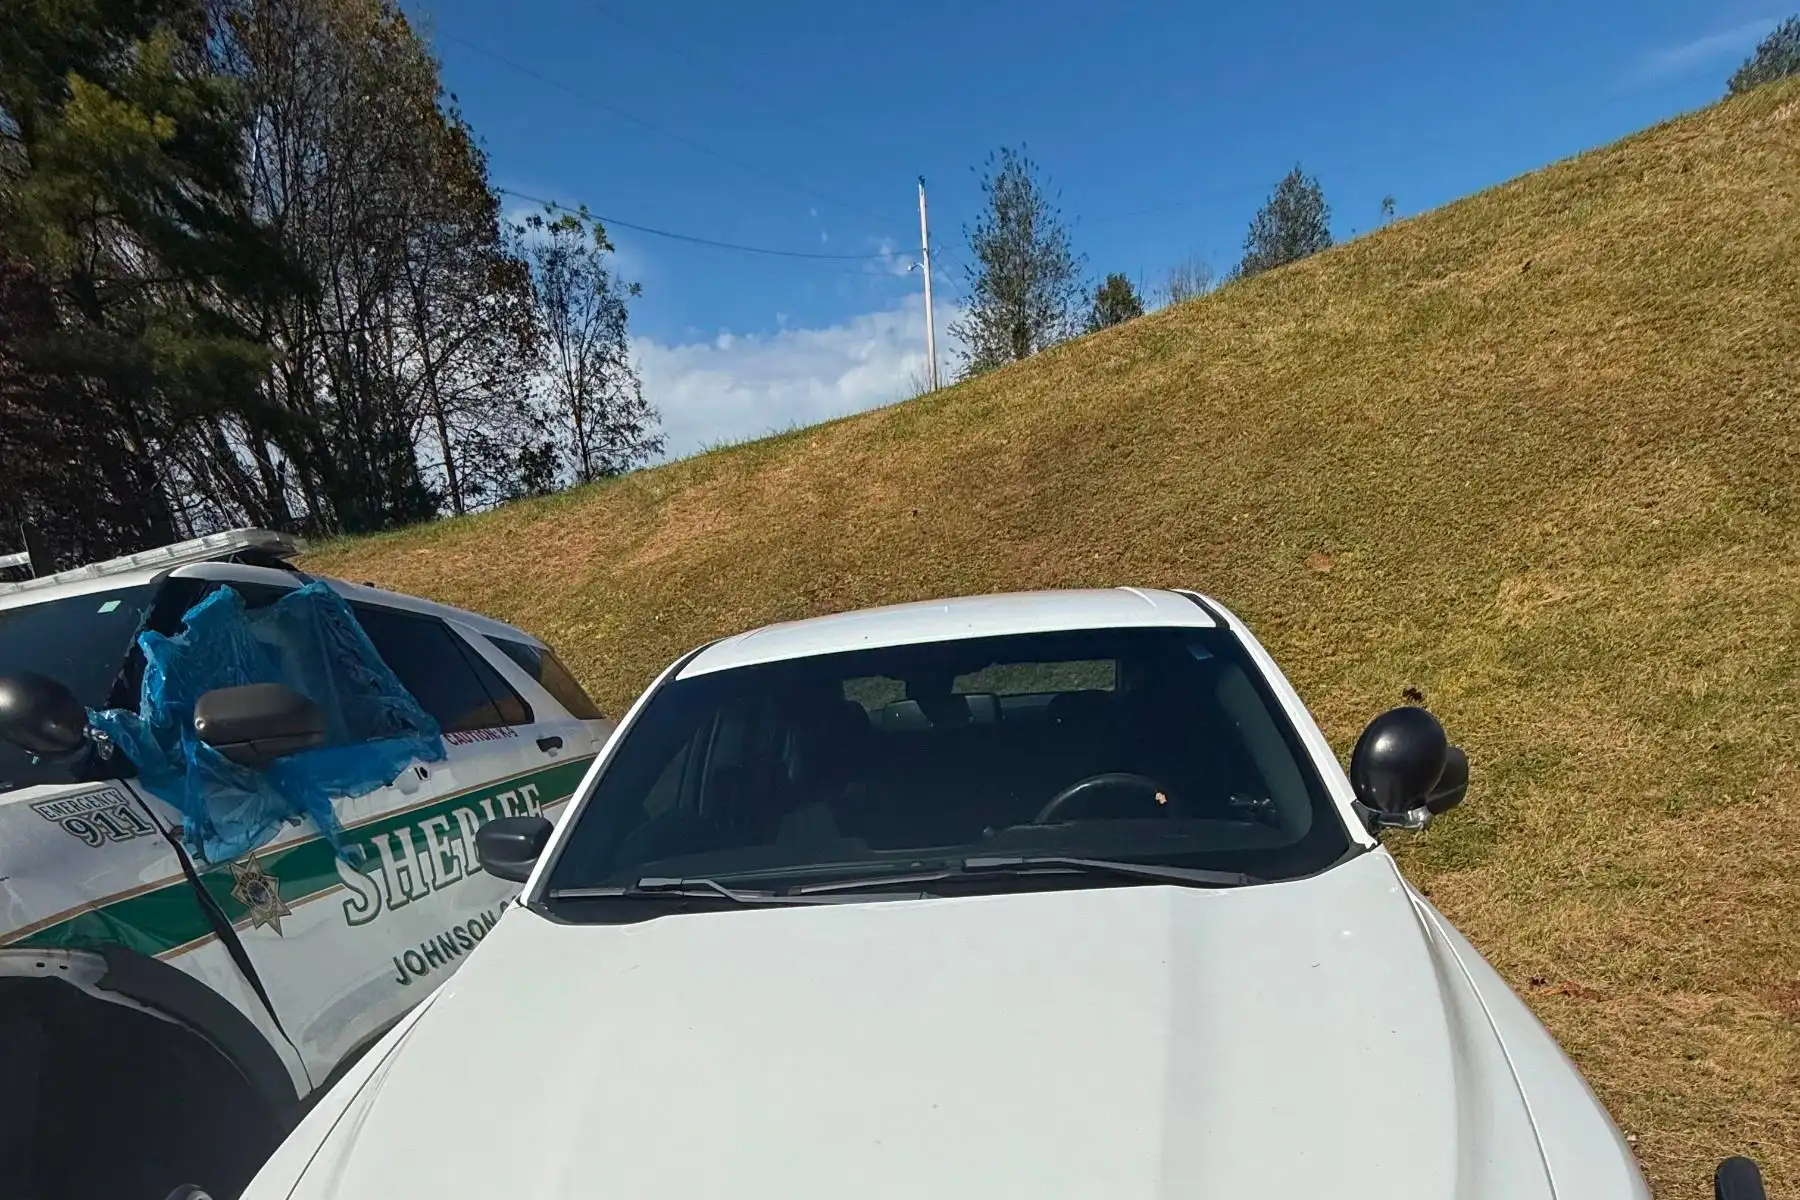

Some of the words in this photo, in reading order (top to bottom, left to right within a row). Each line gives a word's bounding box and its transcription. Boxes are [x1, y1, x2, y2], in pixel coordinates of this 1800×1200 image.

[40, 790, 121, 819] EMERGENCY
[62, 804, 156, 846] 911
[393, 910, 498, 985] JOHNSON
